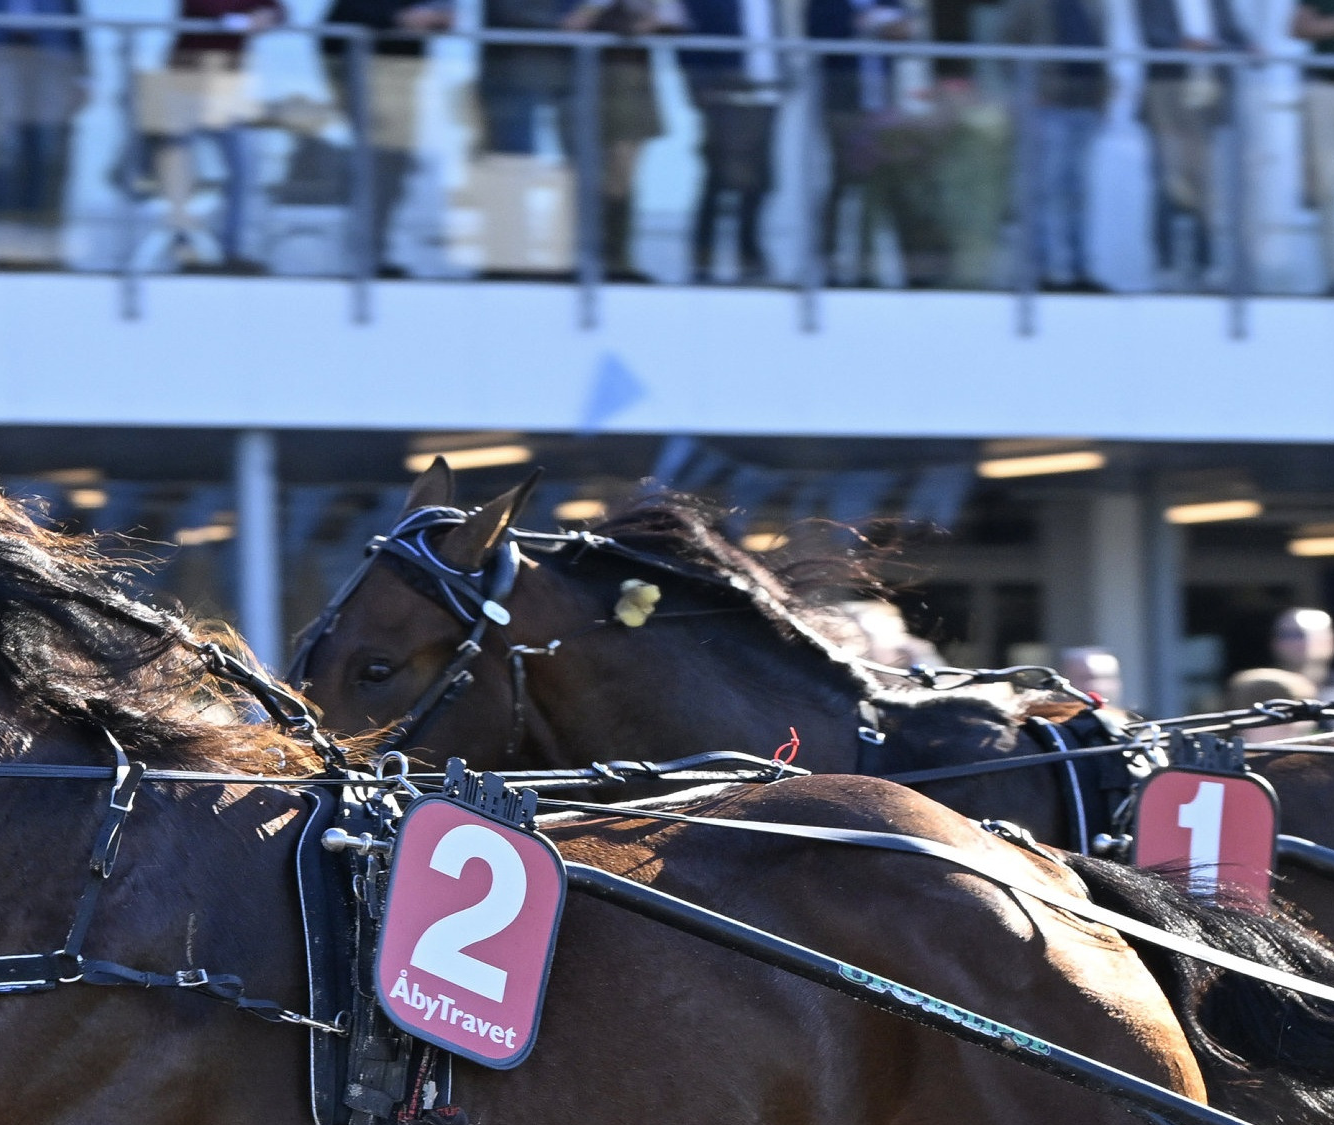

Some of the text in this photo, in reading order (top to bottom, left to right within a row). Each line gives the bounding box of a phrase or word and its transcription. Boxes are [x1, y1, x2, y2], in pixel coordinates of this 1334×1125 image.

[1178, 780, 1225, 906] 1
[409, 823, 528, 1004] 2
[388, 969, 517, 1050] ÅbyTravet
